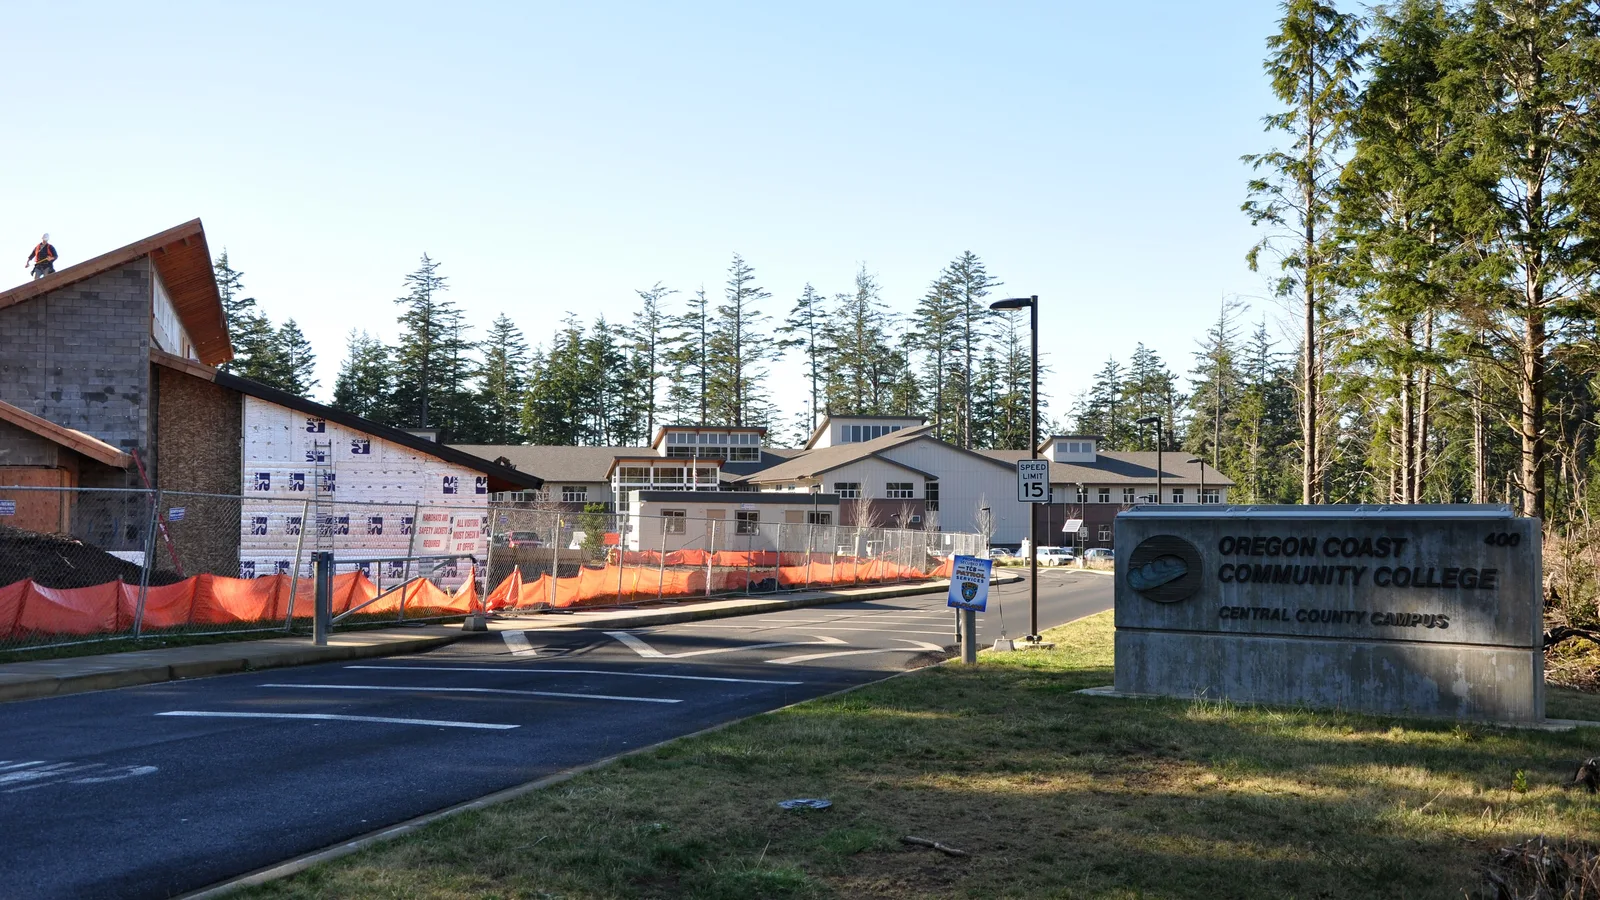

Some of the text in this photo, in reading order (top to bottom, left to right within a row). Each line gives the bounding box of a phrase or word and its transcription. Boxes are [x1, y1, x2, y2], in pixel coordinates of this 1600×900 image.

[1023, 482, 1044, 498] 15
[456, 519, 464, 528] ALL
[464, 519, 479, 528] VISITORS
[419, 526, 448, 535] SAFETY JACKETS
[453, 531, 464, 540] MUST
[464, 530, 476, 539] CHECK
[423, 539, 440, 548] REQUIRED
[1484, 532, 1521, 547] 400
[456, 542, 475, 551] AT OFFICE
[1218, 536, 1408, 558] OREGON COAST
[956, 569, 986, 580] PATROL
[956, 575, 984, 584] SERVICES
[1218, 563, 1498, 589] COMMUNITY COLLEGE
[1219, 606, 1450, 629] CENTRAL COUNTY CAMPUS
